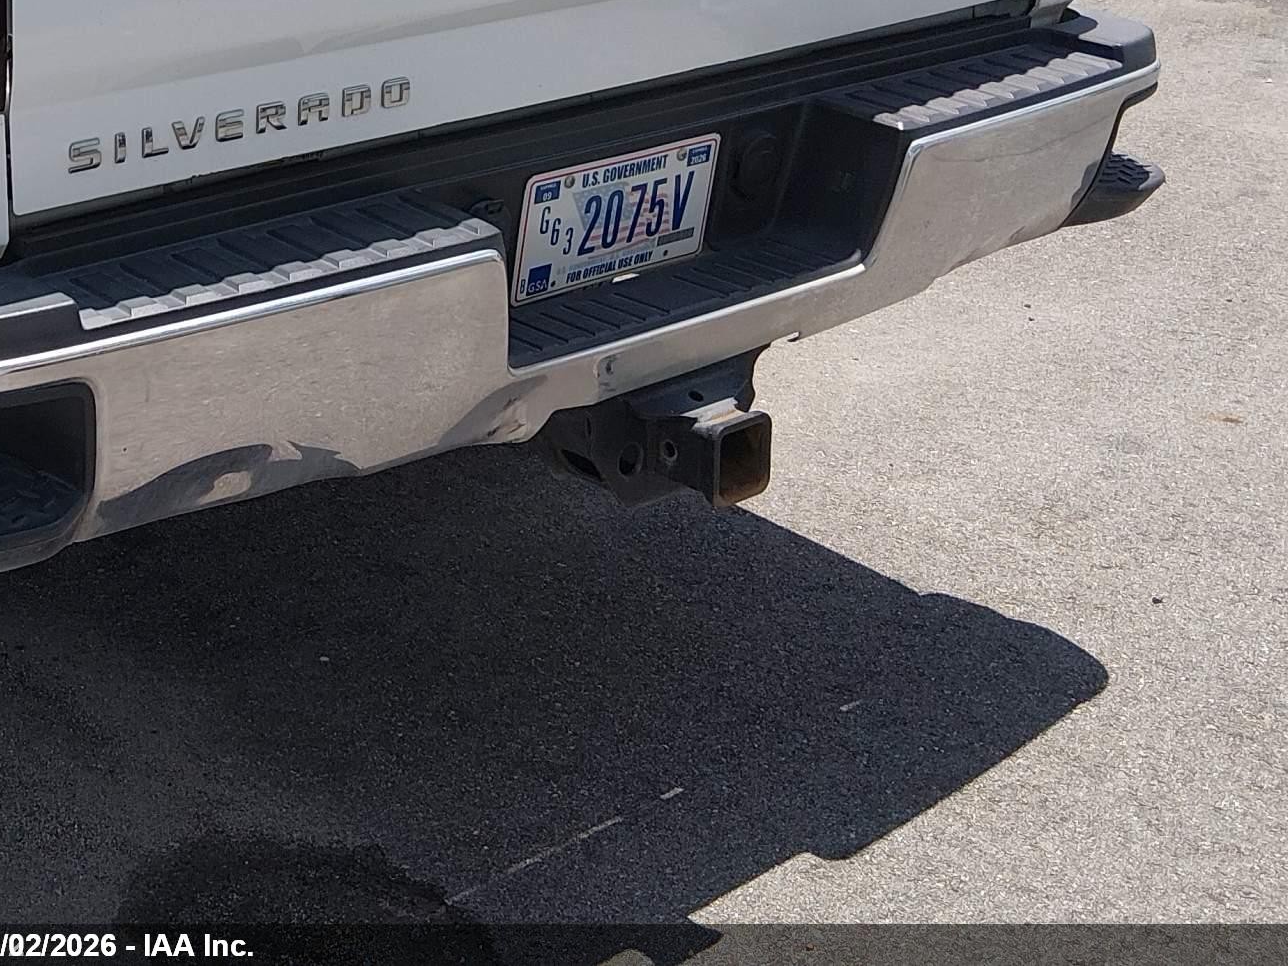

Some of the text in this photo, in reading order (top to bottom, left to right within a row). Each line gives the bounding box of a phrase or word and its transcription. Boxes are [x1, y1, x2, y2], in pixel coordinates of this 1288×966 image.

[67, 76, 411, 174] SILVERADO
[581, 154, 669, 189] U.S. GOVERNMENT
[577, 170, 696, 256] 2075V
[566, 250, 655, 284] FOR OFFICIAL USE ONLY
[527, 278, 549, 293] GSA
